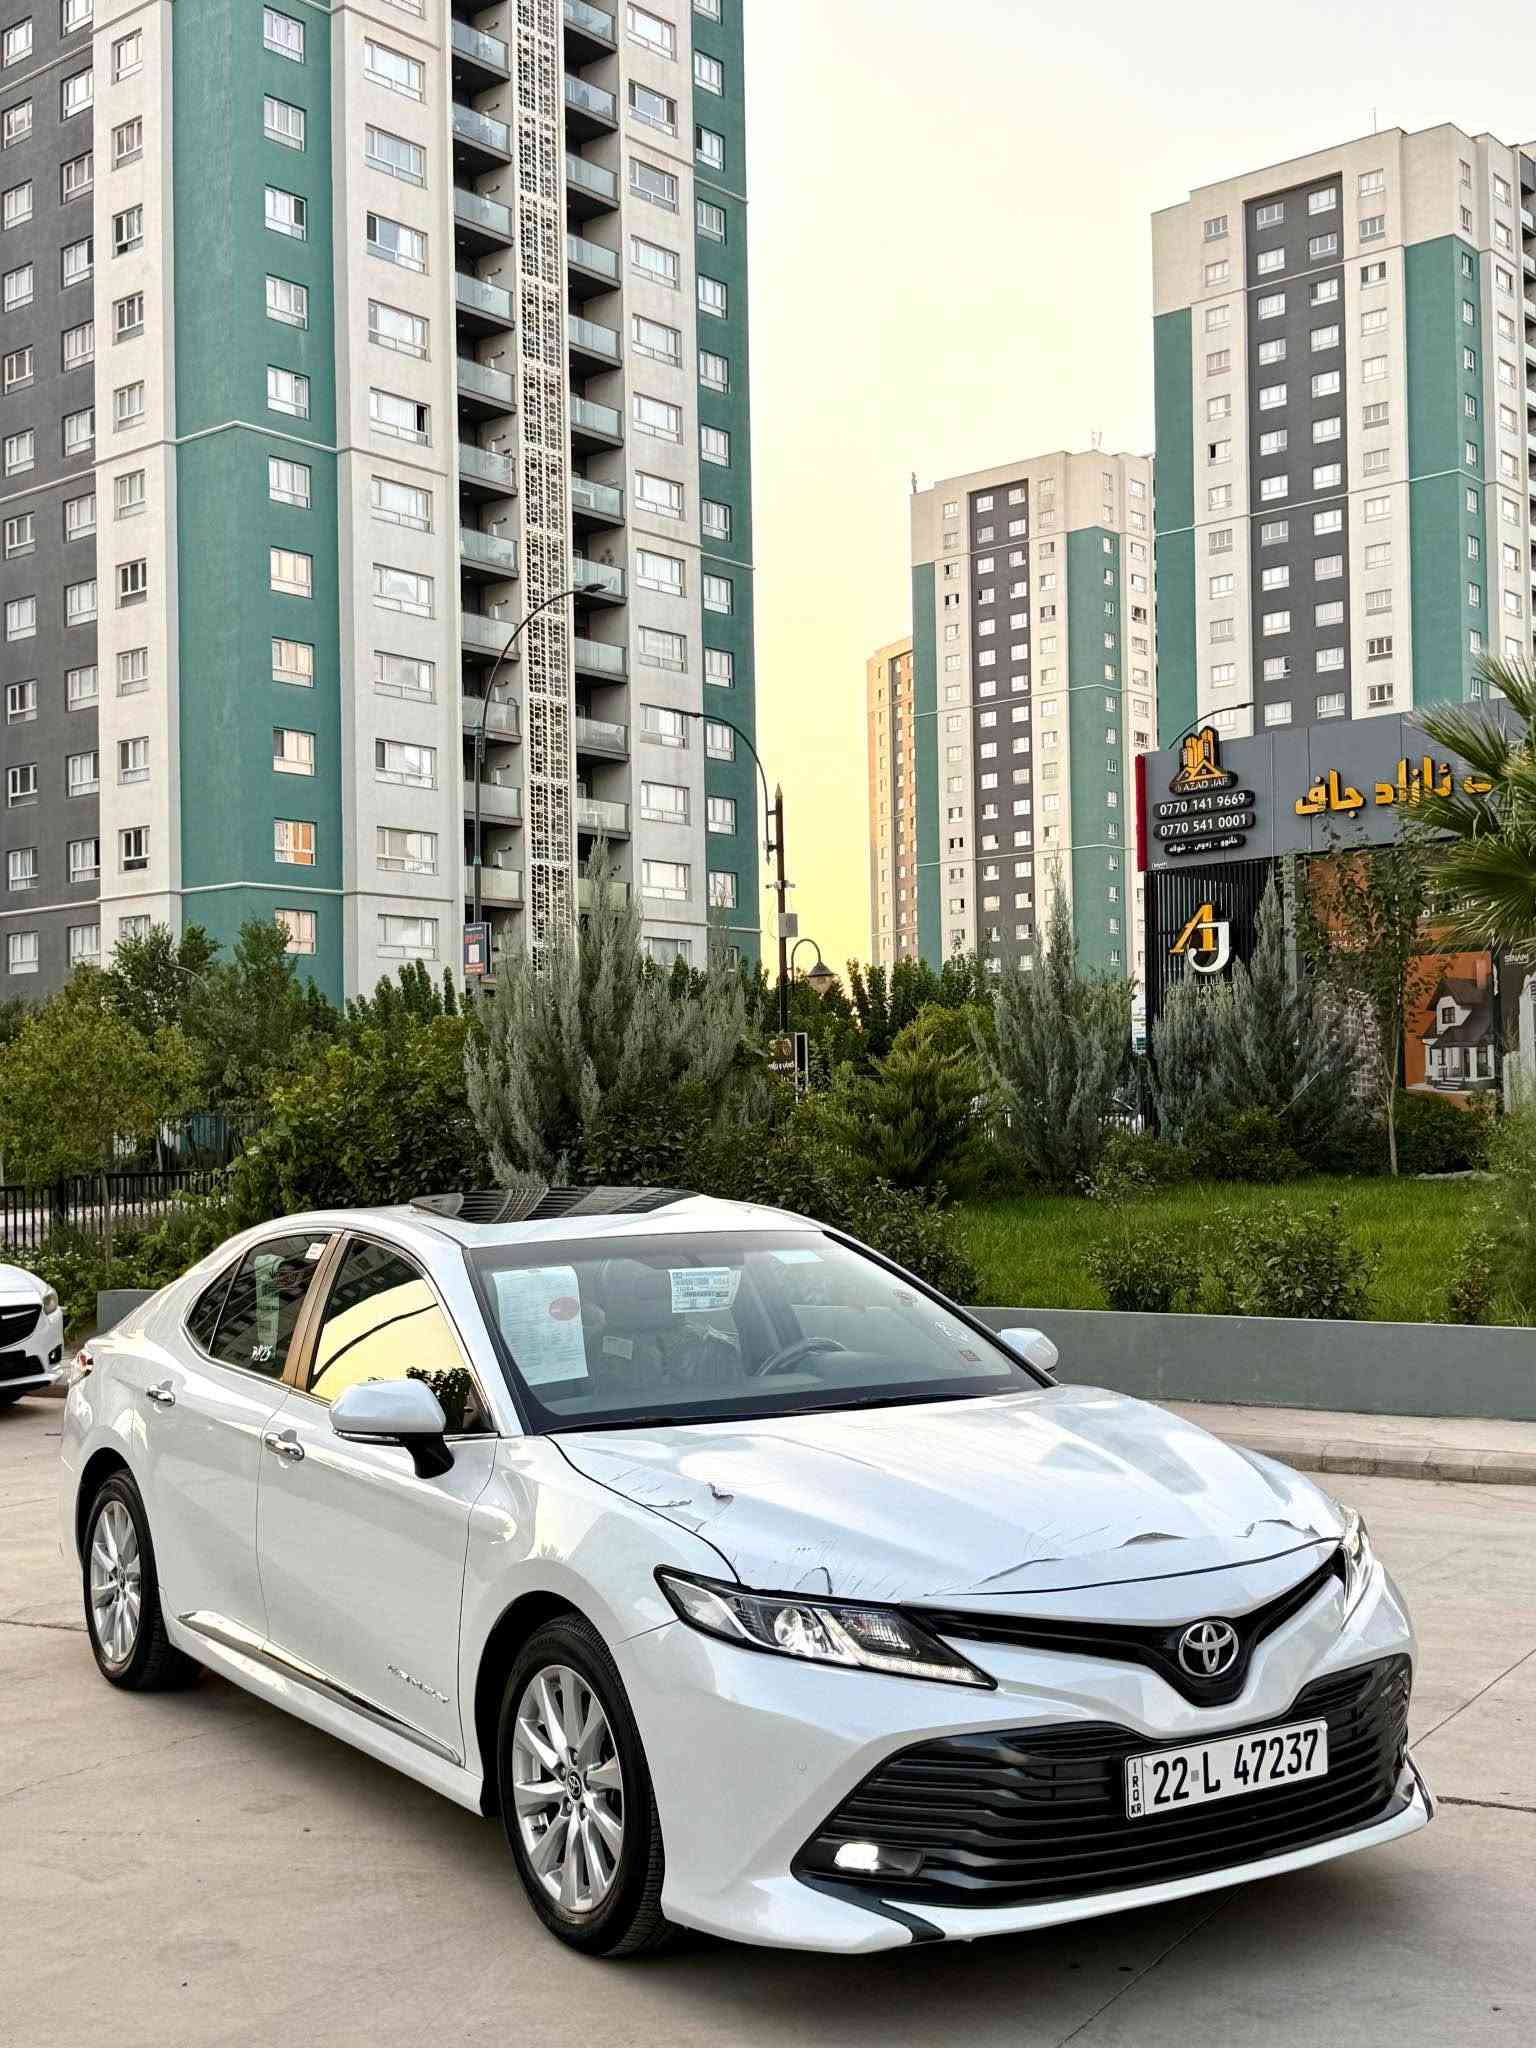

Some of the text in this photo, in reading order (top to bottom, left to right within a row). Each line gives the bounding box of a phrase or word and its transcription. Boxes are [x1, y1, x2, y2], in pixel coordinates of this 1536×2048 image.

[1183, 776, 1229, 792] AZAD JAF
[1295, 768, 1365, 818] جاف
[1159, 792, 1246, 816] 0770 141 9669
[1160, 814, 1247, 836] 0770 541 0001
[1152, 1728, 1319, 1806] 22 L 47237
[1131, 1803, 1142, 1815] KR
